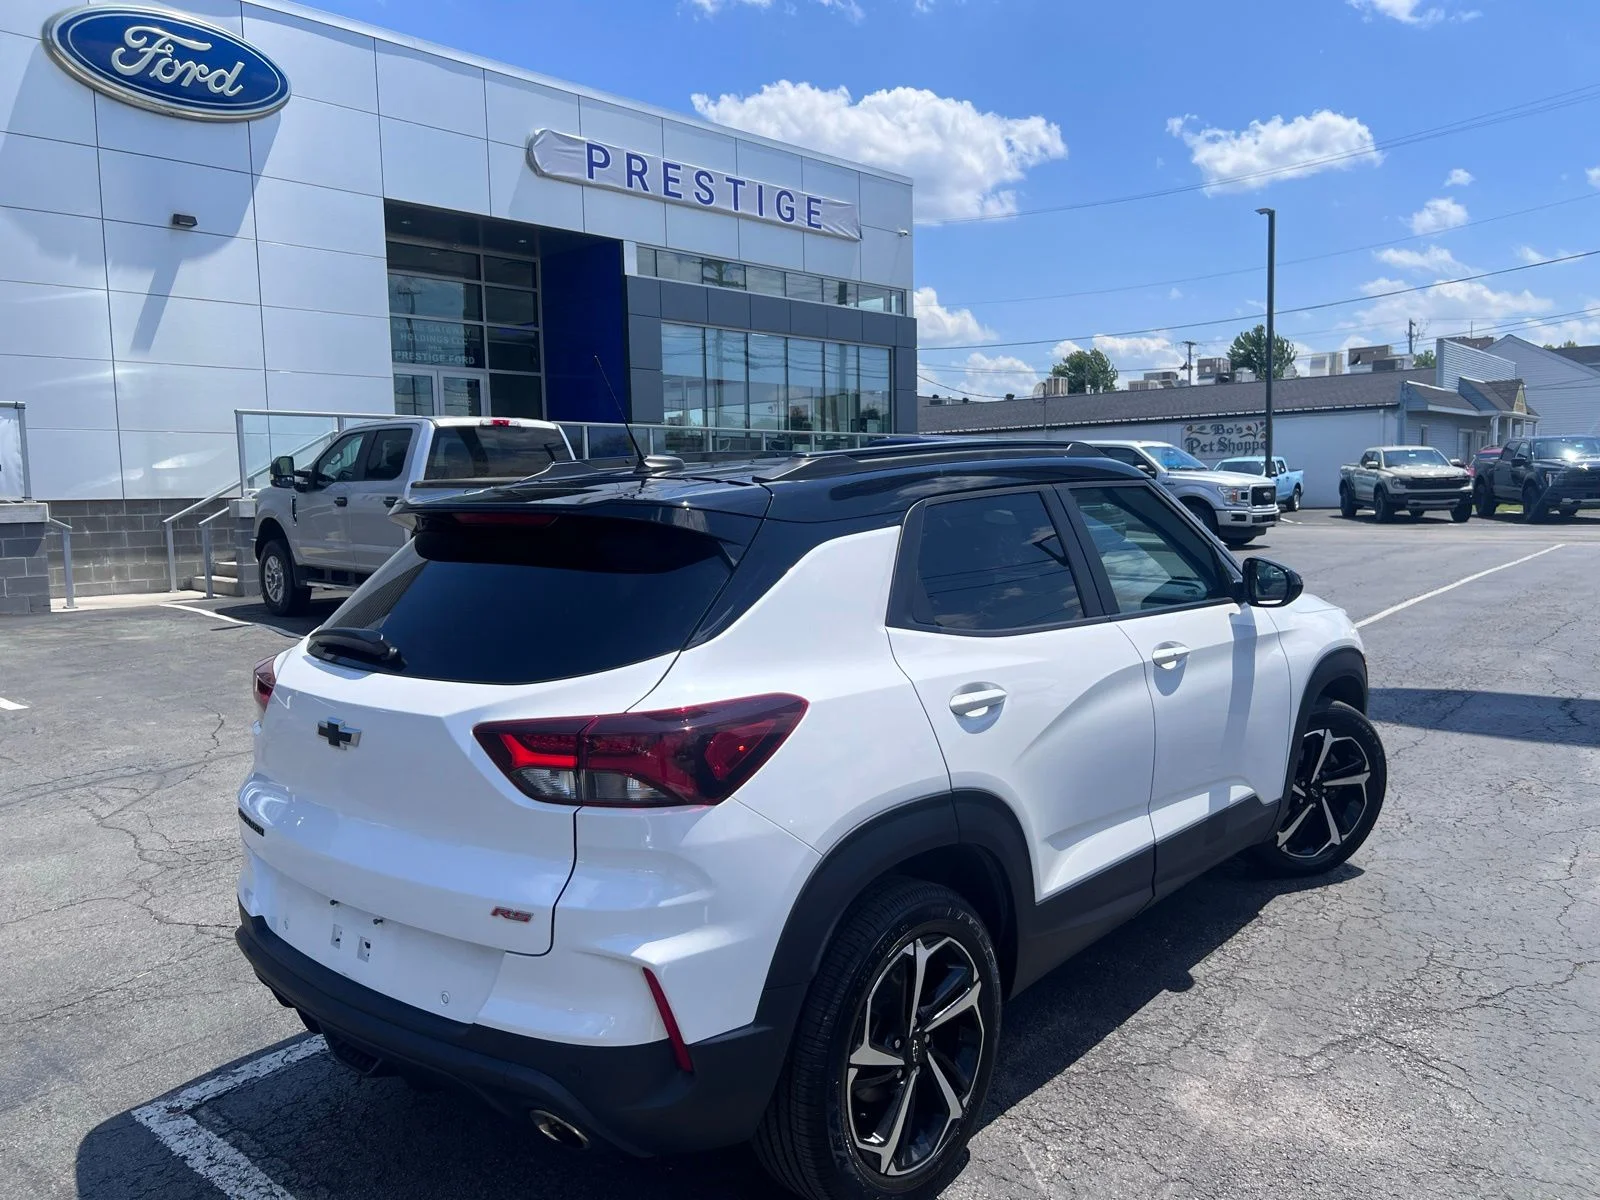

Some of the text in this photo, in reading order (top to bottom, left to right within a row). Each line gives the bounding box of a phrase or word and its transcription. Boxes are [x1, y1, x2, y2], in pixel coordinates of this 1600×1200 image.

[111, 26, 245, 97] Ford
[586, 142, 822, 230] PRESTIGE
[394, 350, 475, 365] PRESTIGE FORD
[1210, 423, 1243, 435] Bo's
[1184, 437, 1215, 455] Pet
[491, 906, 533, 922] RS
